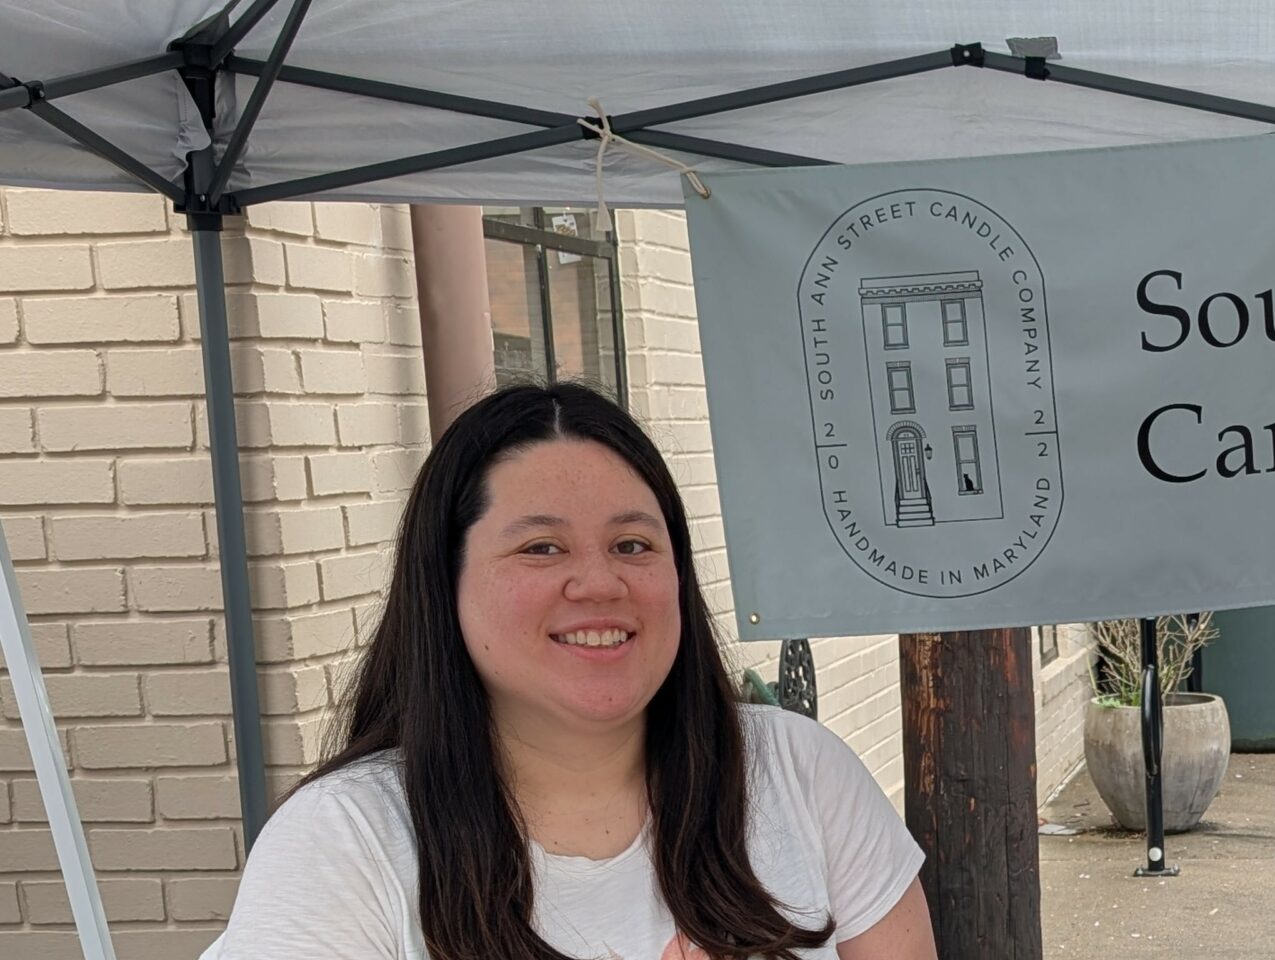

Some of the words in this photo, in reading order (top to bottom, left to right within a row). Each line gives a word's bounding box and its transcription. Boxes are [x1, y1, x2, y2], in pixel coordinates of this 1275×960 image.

[837, 200, 916, 251] STREET
[929, 201, 1015, 262] CANDLE
[811, 254, 840, 305] ANN
[1011, 269, 1043, 391] COMPANY
[811, 317, 835, 401] SOUTH
[824, 423, 835, 437] 2
[1034, 410, 1045, 424] 2
[1037, 443, 1048, 457] 2
[832, 489, 929, 584] HANDMADE
[940, 570, 962, 585] IN
[973, 476, 1051, 580] MARYLAND
